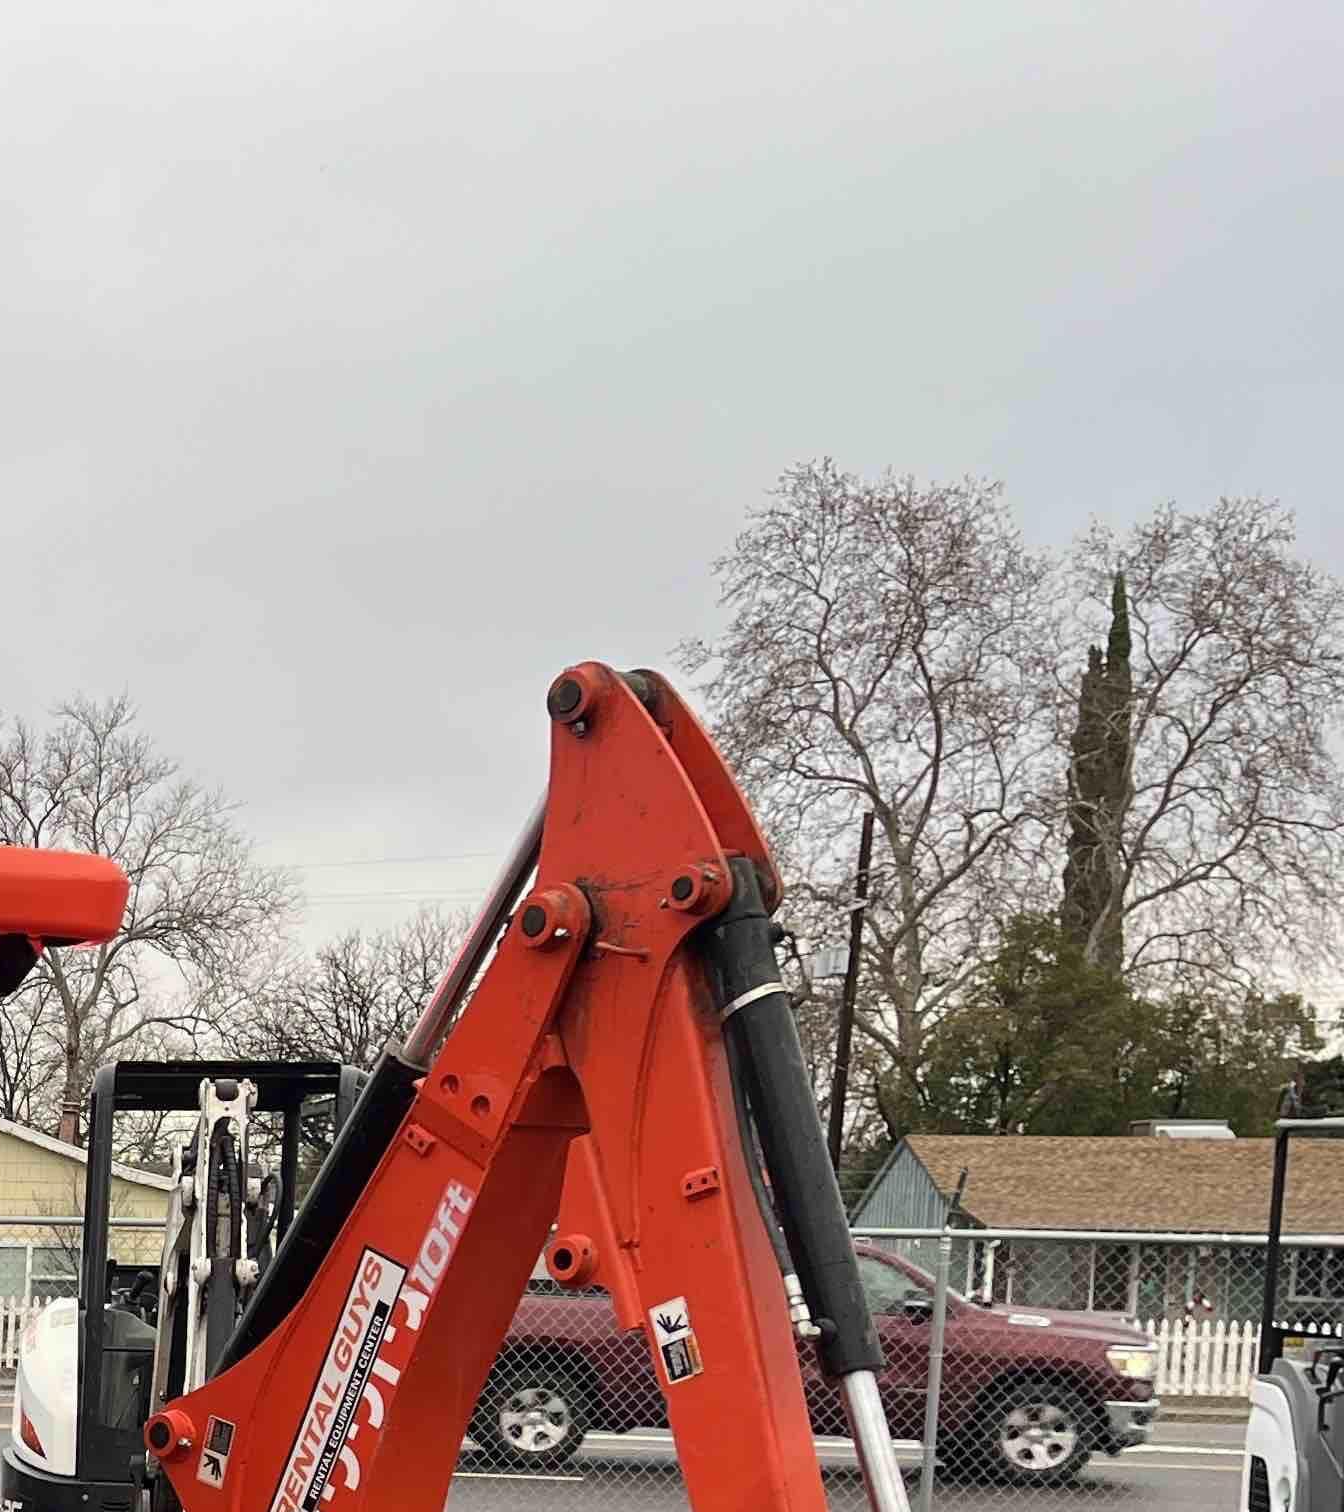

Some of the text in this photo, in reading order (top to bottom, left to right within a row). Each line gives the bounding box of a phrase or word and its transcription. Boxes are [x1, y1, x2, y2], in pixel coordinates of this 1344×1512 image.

[411, 1182, 473, 1295] 10ft
[333, 1255, 383, 1373] GUYS
[310, 1314, 385, 1501] RENTAL EQUIPMENT CENTER
